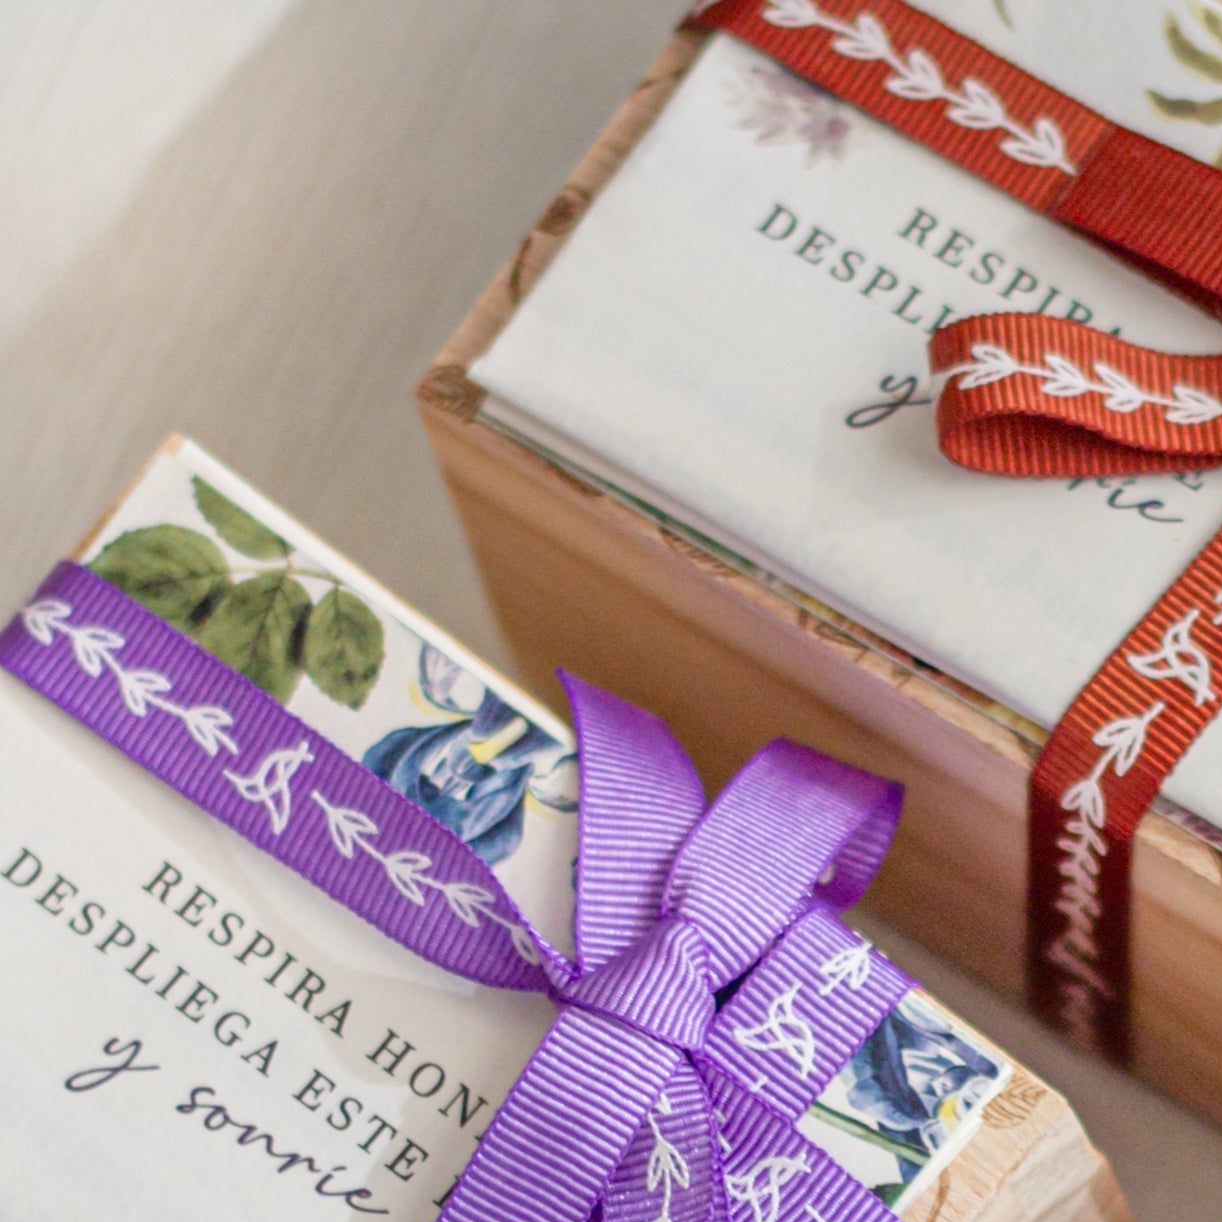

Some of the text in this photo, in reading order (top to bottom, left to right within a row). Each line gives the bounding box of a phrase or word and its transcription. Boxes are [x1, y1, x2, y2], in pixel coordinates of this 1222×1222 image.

[756, 203, 957, 336] DESPLI
[899, 206, 1123, 341] RESPIR
[845, 371, 934, 428] y
[1, 847, 430, 1182] DESPLIEGA ESTE
[63, 1036, 161, 1093] y
[141, 861, 489, 1138] RESPIRA HON
